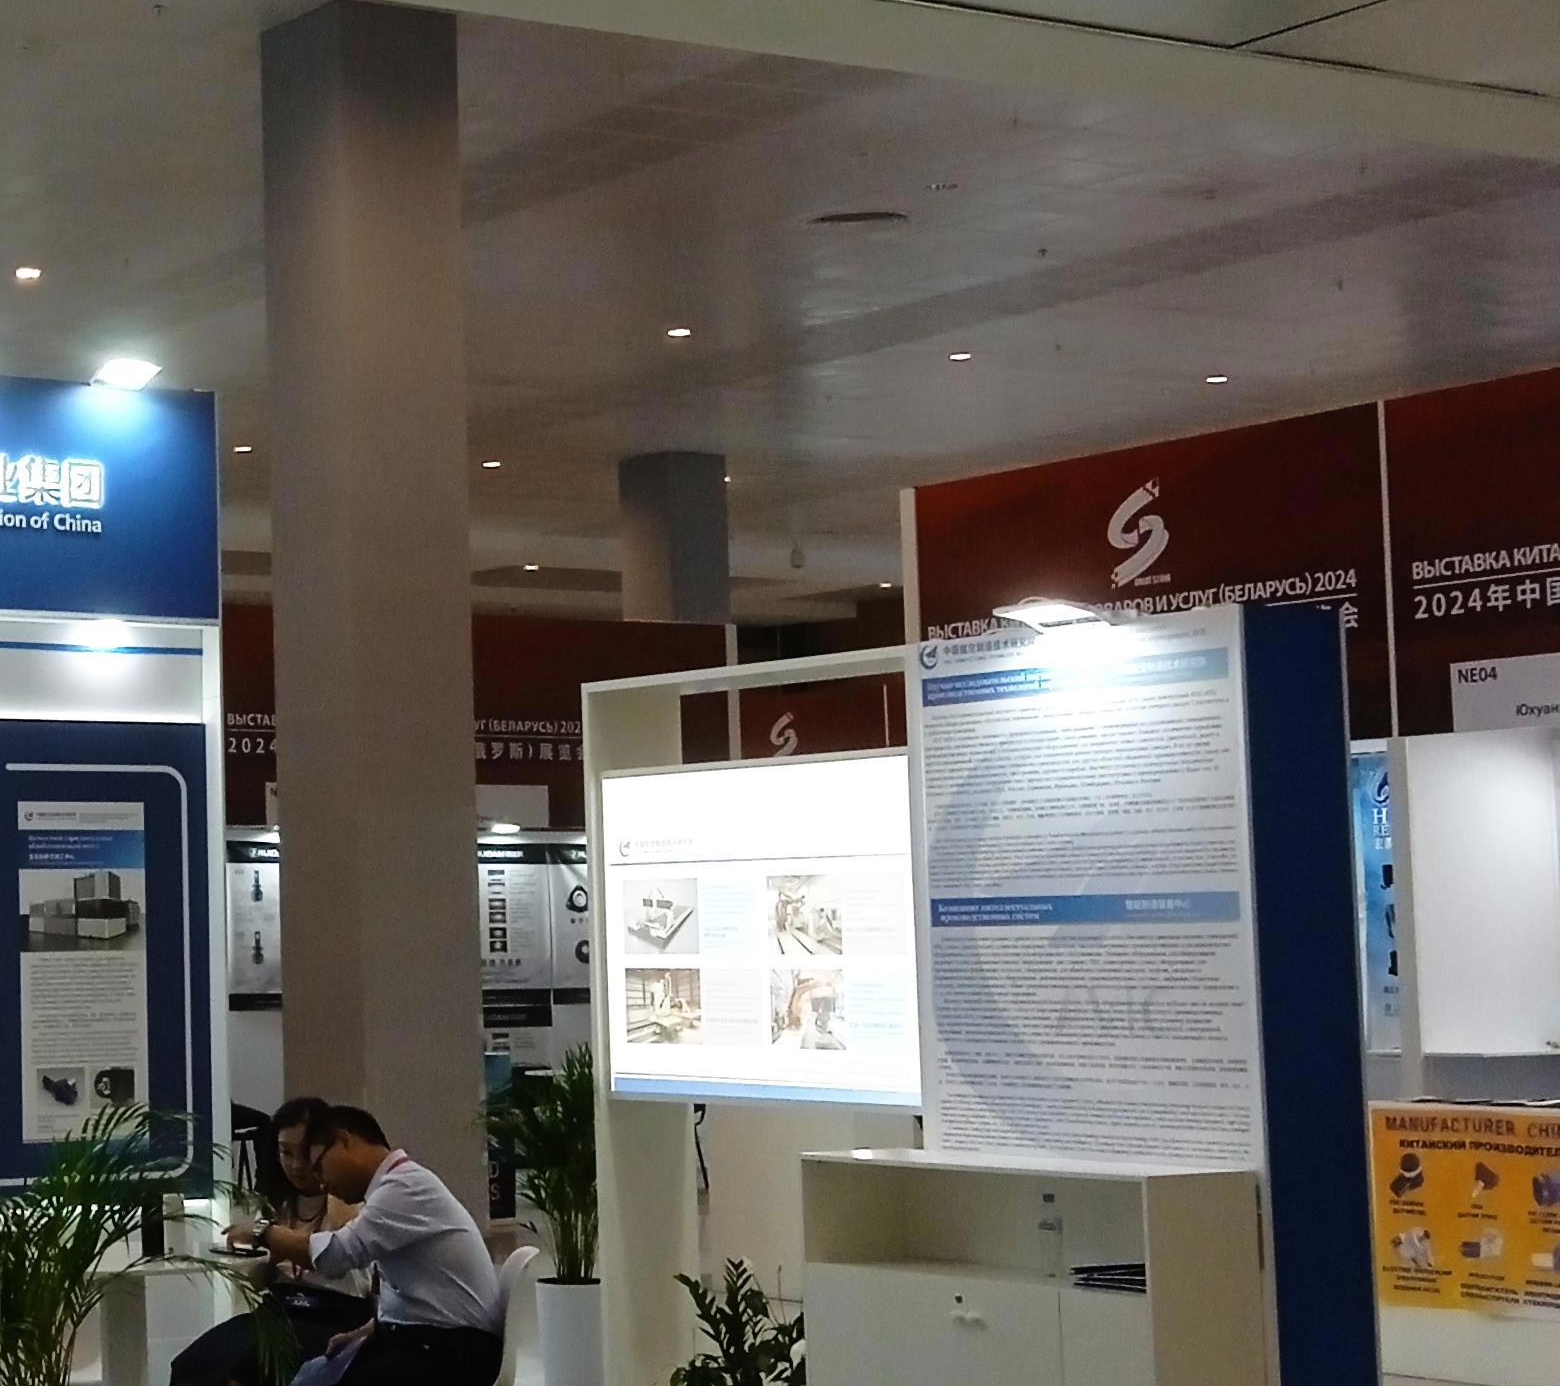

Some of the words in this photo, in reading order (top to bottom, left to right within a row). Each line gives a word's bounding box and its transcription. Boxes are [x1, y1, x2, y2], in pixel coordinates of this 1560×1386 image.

[30, 511, 50, 529] of
[53, 513, 103, 533] China
[1412, 549, 1511, 580] ВЫСТАВКА
[1155, 594, 1168, 613] И
[1168, 587, 1218, 611] УСЛУГ
[1219, 572, 1312, 605] (БЕЛАРУСЬ)
[1314, 569, 1358, 592] 2024
[1457, 666, 1498, 684] NE04
[560, 721, 582, 734] 202
[1385, 1115, 1516, 1137] MANUFACTURER
